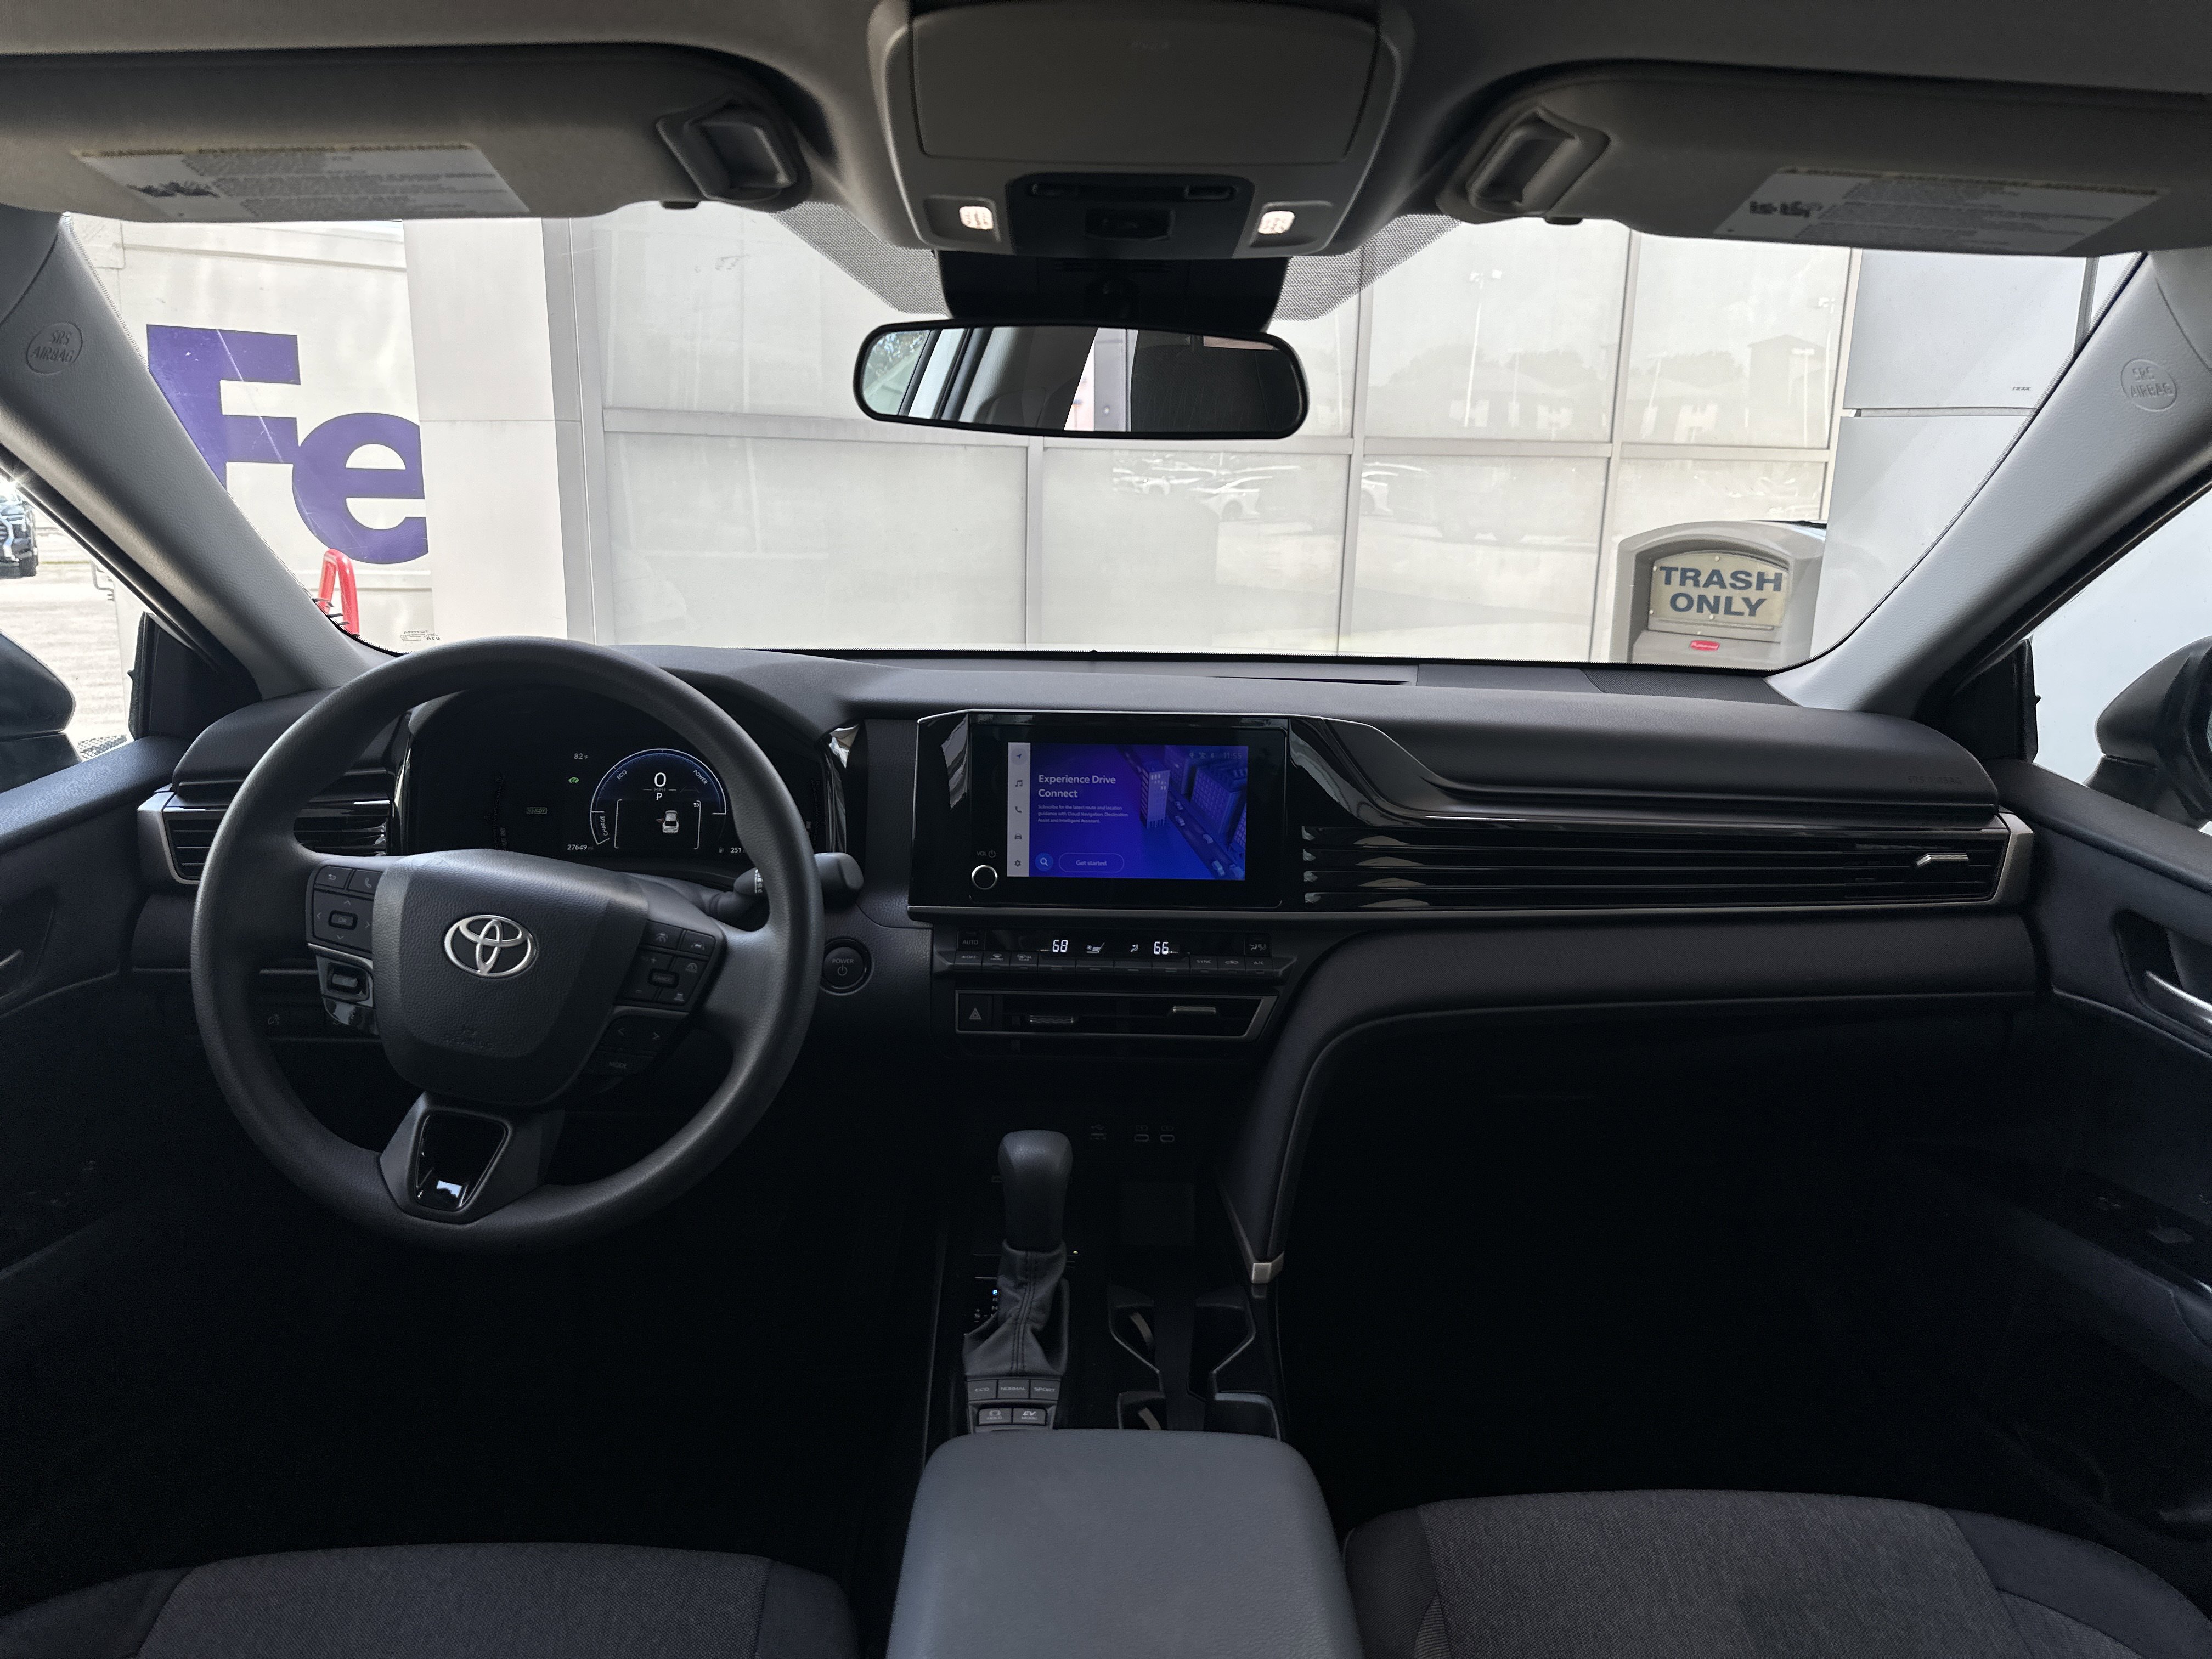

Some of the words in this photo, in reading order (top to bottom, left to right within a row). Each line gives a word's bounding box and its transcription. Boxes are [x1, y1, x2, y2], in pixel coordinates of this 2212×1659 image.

[50, 330, 72, 345] SRS
[31, 346, 75, 362] AIRBAG
[1660, 566, 1782, 591] TRASH
[1670, 592, 1767, 617] ONLY
[616, 770, 627, 780] ECO
[654, 772, 667, 787] 0
[693, 769, 708, 785] POWER
[1039, 775, 1090, 785] Experience
[1092, 775, 1116, 784] Drive
[656, 792, 663, 800] P
[1038, 788, 1079, 798] Connect
[1052, 939, 1068, 953] 68
[1153, 941, 1169, 955] 66
